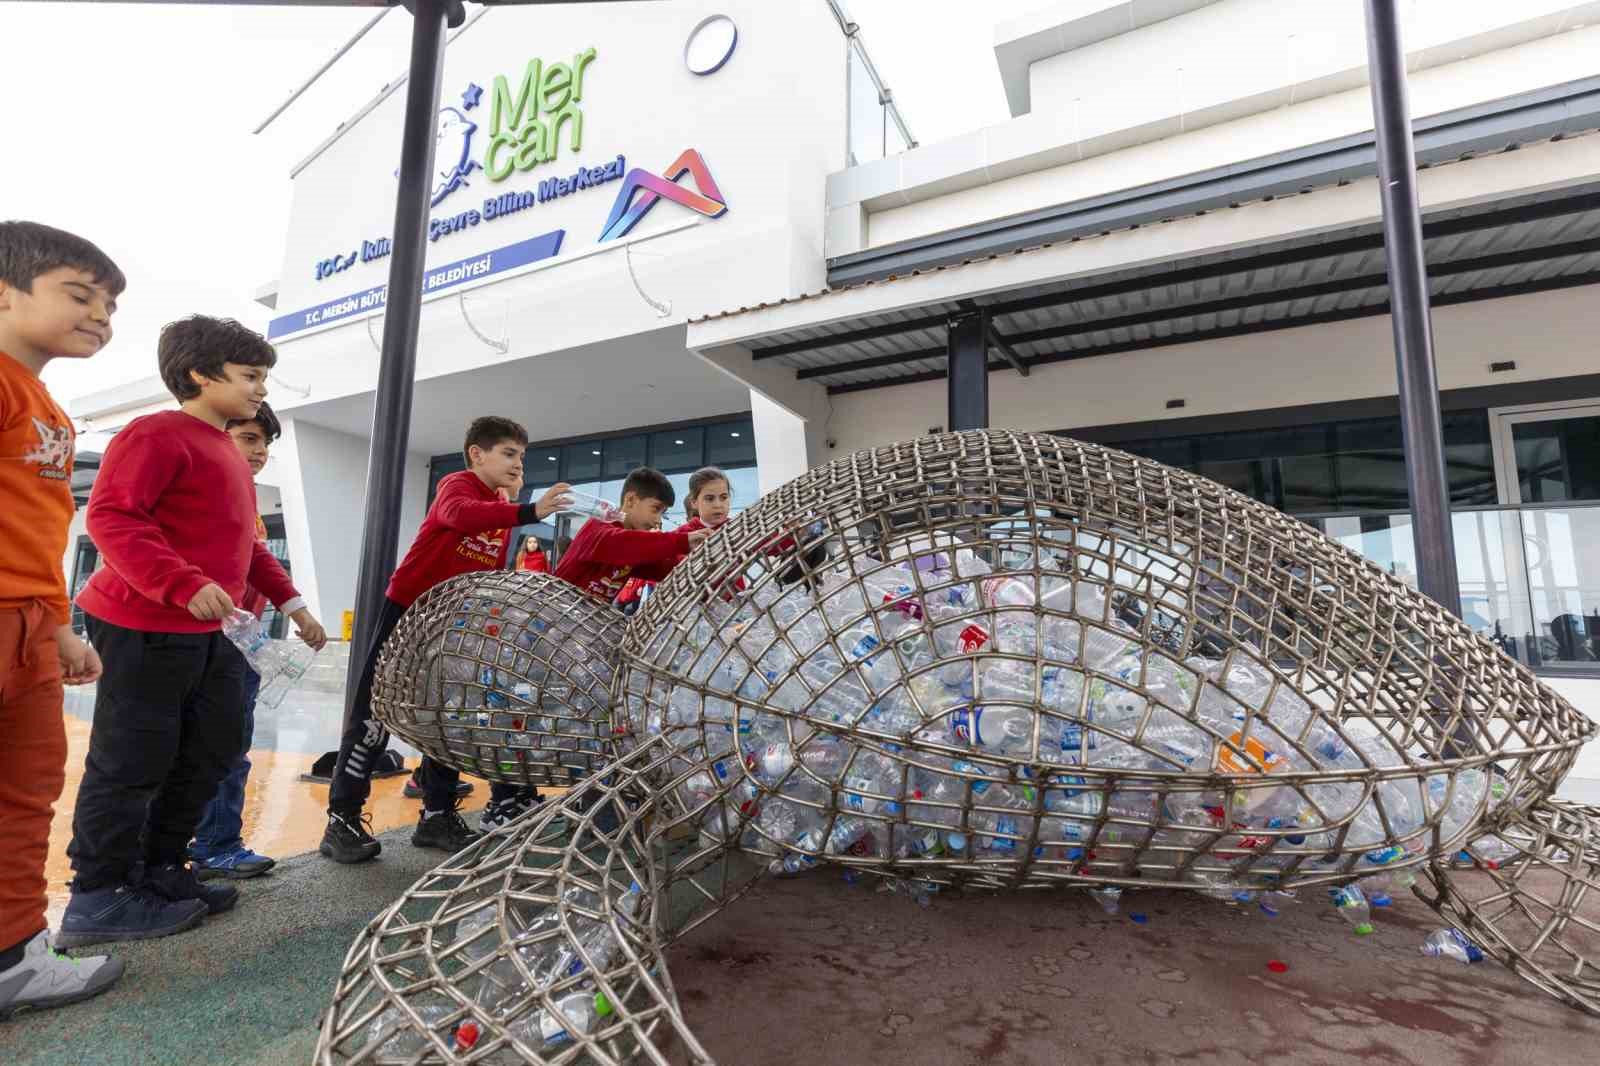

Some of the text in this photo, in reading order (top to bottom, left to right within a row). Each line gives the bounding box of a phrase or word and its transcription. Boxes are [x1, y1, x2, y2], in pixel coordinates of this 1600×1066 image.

[489, 47, 596, 137] Mer
[484, 103, 582, 182] can
[429, 155, 625, 242] Çevre Bilim Merkezi
[428, 255, 490, 288] BELEDİYESİ
